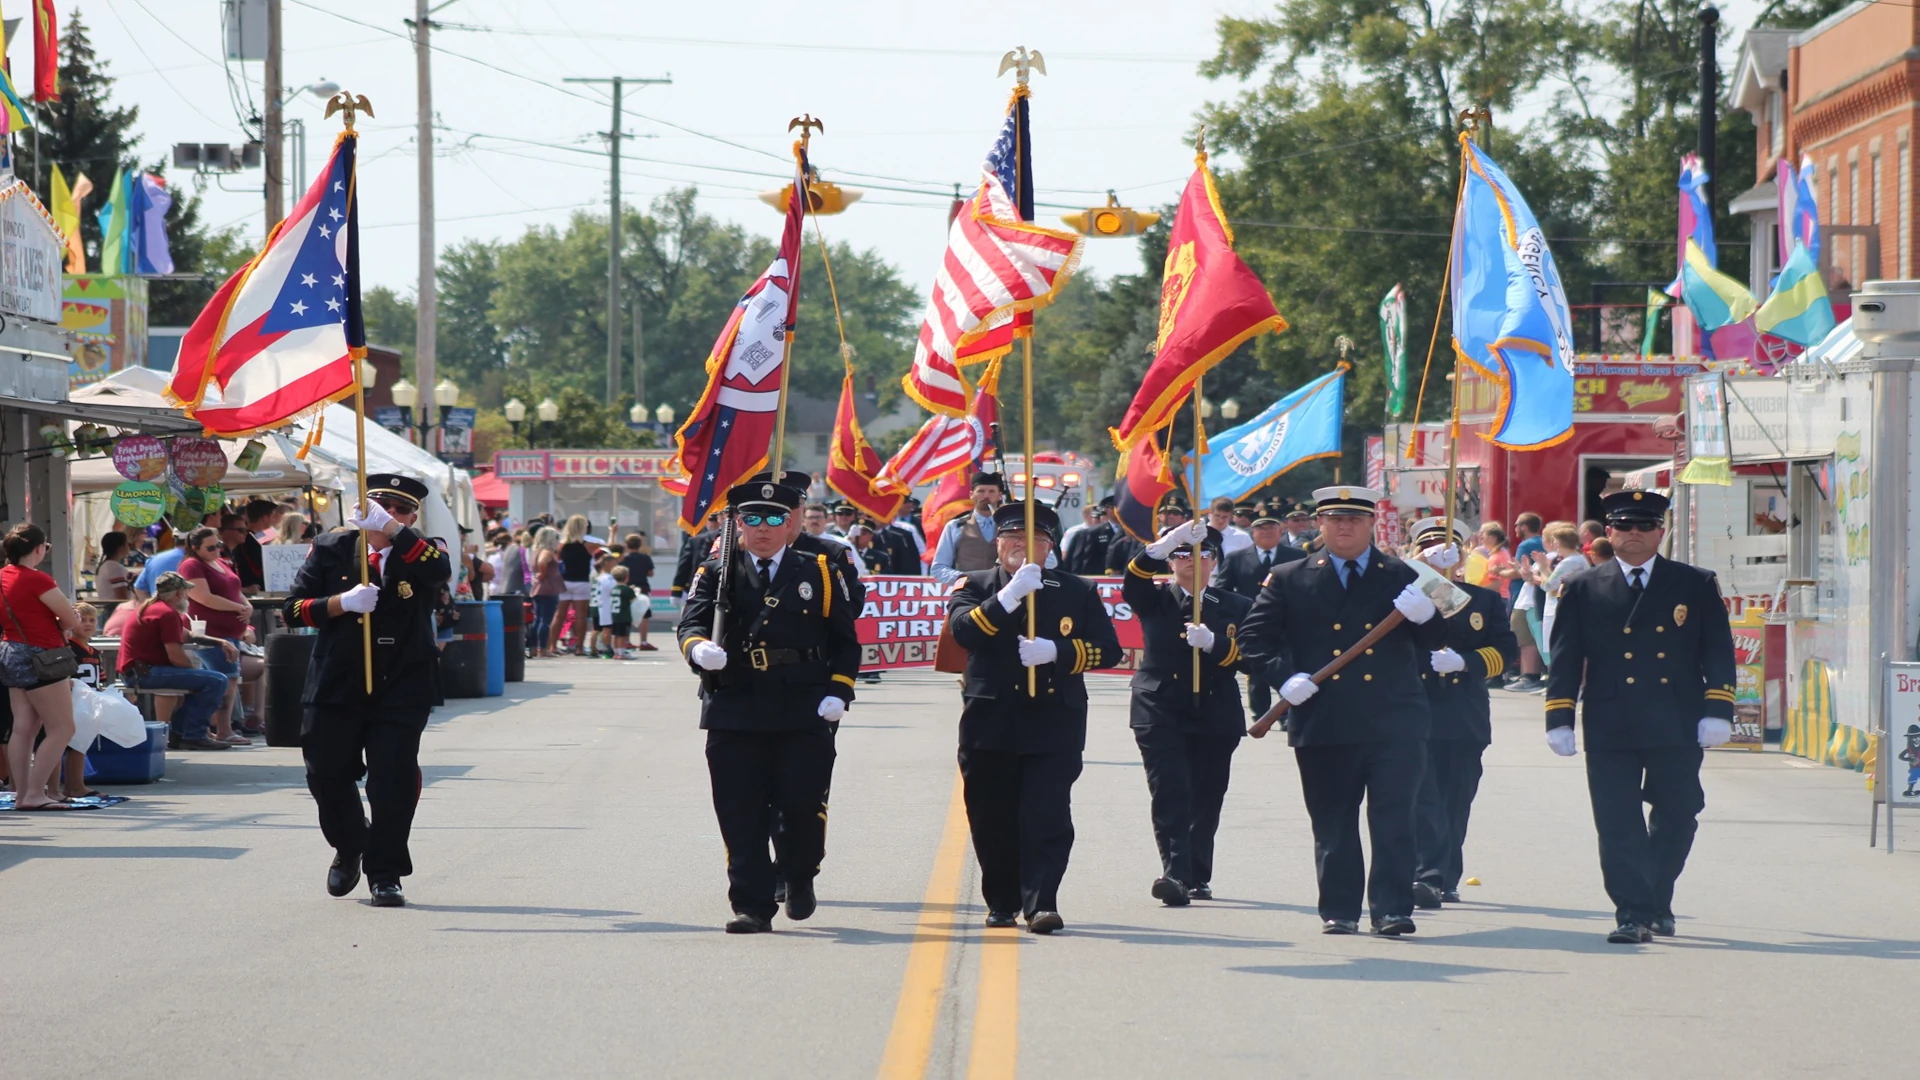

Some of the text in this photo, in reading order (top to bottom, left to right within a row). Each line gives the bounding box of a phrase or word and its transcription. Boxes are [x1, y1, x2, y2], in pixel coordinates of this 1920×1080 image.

[501, 457, 543, 475] TICKETS
[116, 490, 162, 499] LEMONADE
[1376, 502, 1388, 549] ITALIA
